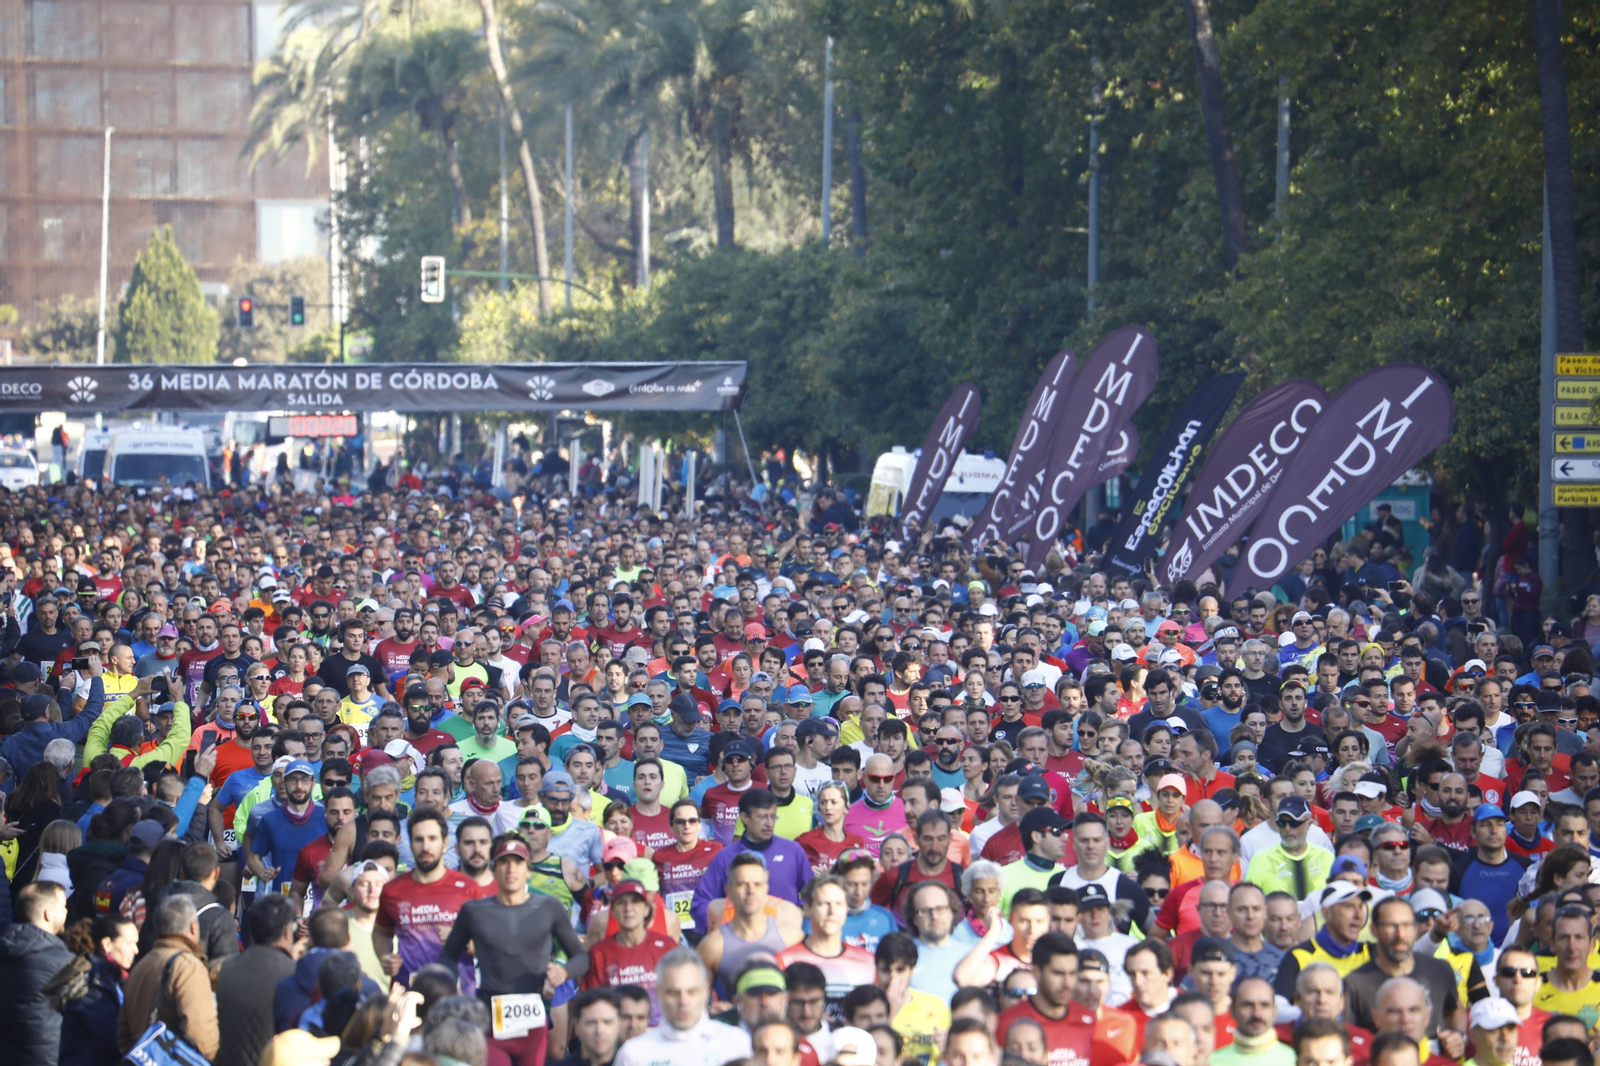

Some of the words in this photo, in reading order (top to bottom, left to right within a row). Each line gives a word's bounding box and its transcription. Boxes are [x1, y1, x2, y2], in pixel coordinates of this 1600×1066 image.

[127, 373, 154, 391] 36
[160, 372, 231, 391] MEDIA
[237, 368, 348, 391] MARATÓN
[355, 372, 382, 390] DE
[389, 368, 498, 390] CÓRDOBA
[1561, 386, 1587, 394] PASEO
[287, 393, 343, 406] SALIDA
[1036, 333, 1143, 541] IMDECO
[1247, 376, 1434, 578] IMDECO
[1558, 495, 1589, 504] Parking
[646, 832, 669, 841] MEDIA
[672, 864, 693, 872] MEDIA
[411, 904, 440, 915] MEDIA
[619, 964, 646, 976] MEDIA
[503, 1003, 542, 1019] 2086
